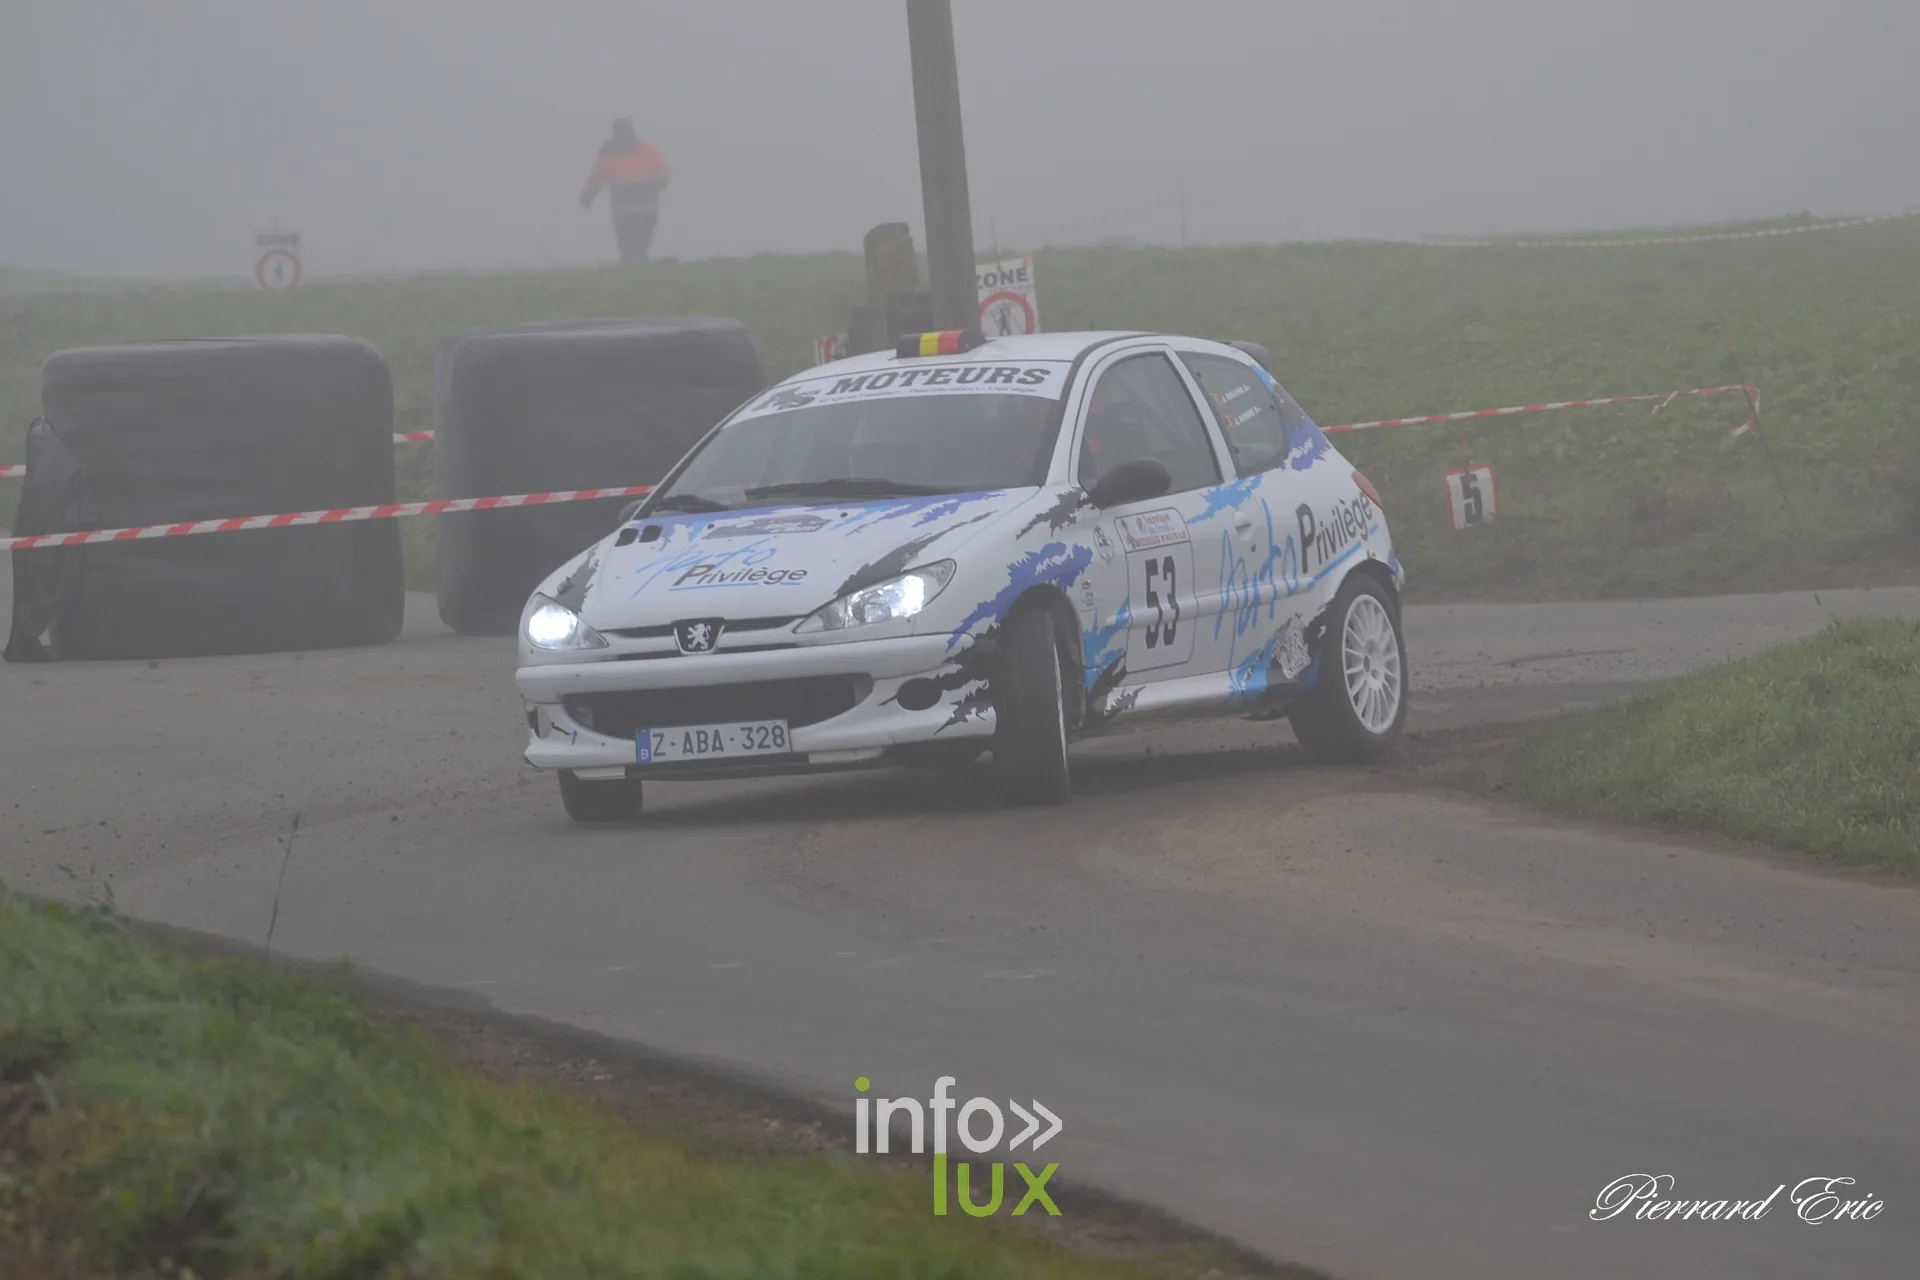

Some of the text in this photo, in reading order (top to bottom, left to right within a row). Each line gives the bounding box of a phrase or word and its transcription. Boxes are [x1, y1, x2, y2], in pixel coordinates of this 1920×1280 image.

[826, 366, 1052, 396] MOTEURS
[1459, 473, 1482, 524] 5
[1295, 492, 1373, 575] Privilège
[673, 564, 808, 585] Privilège
[1145, 556, 1180, 649] 53
[640, 749, 649, 760] B
